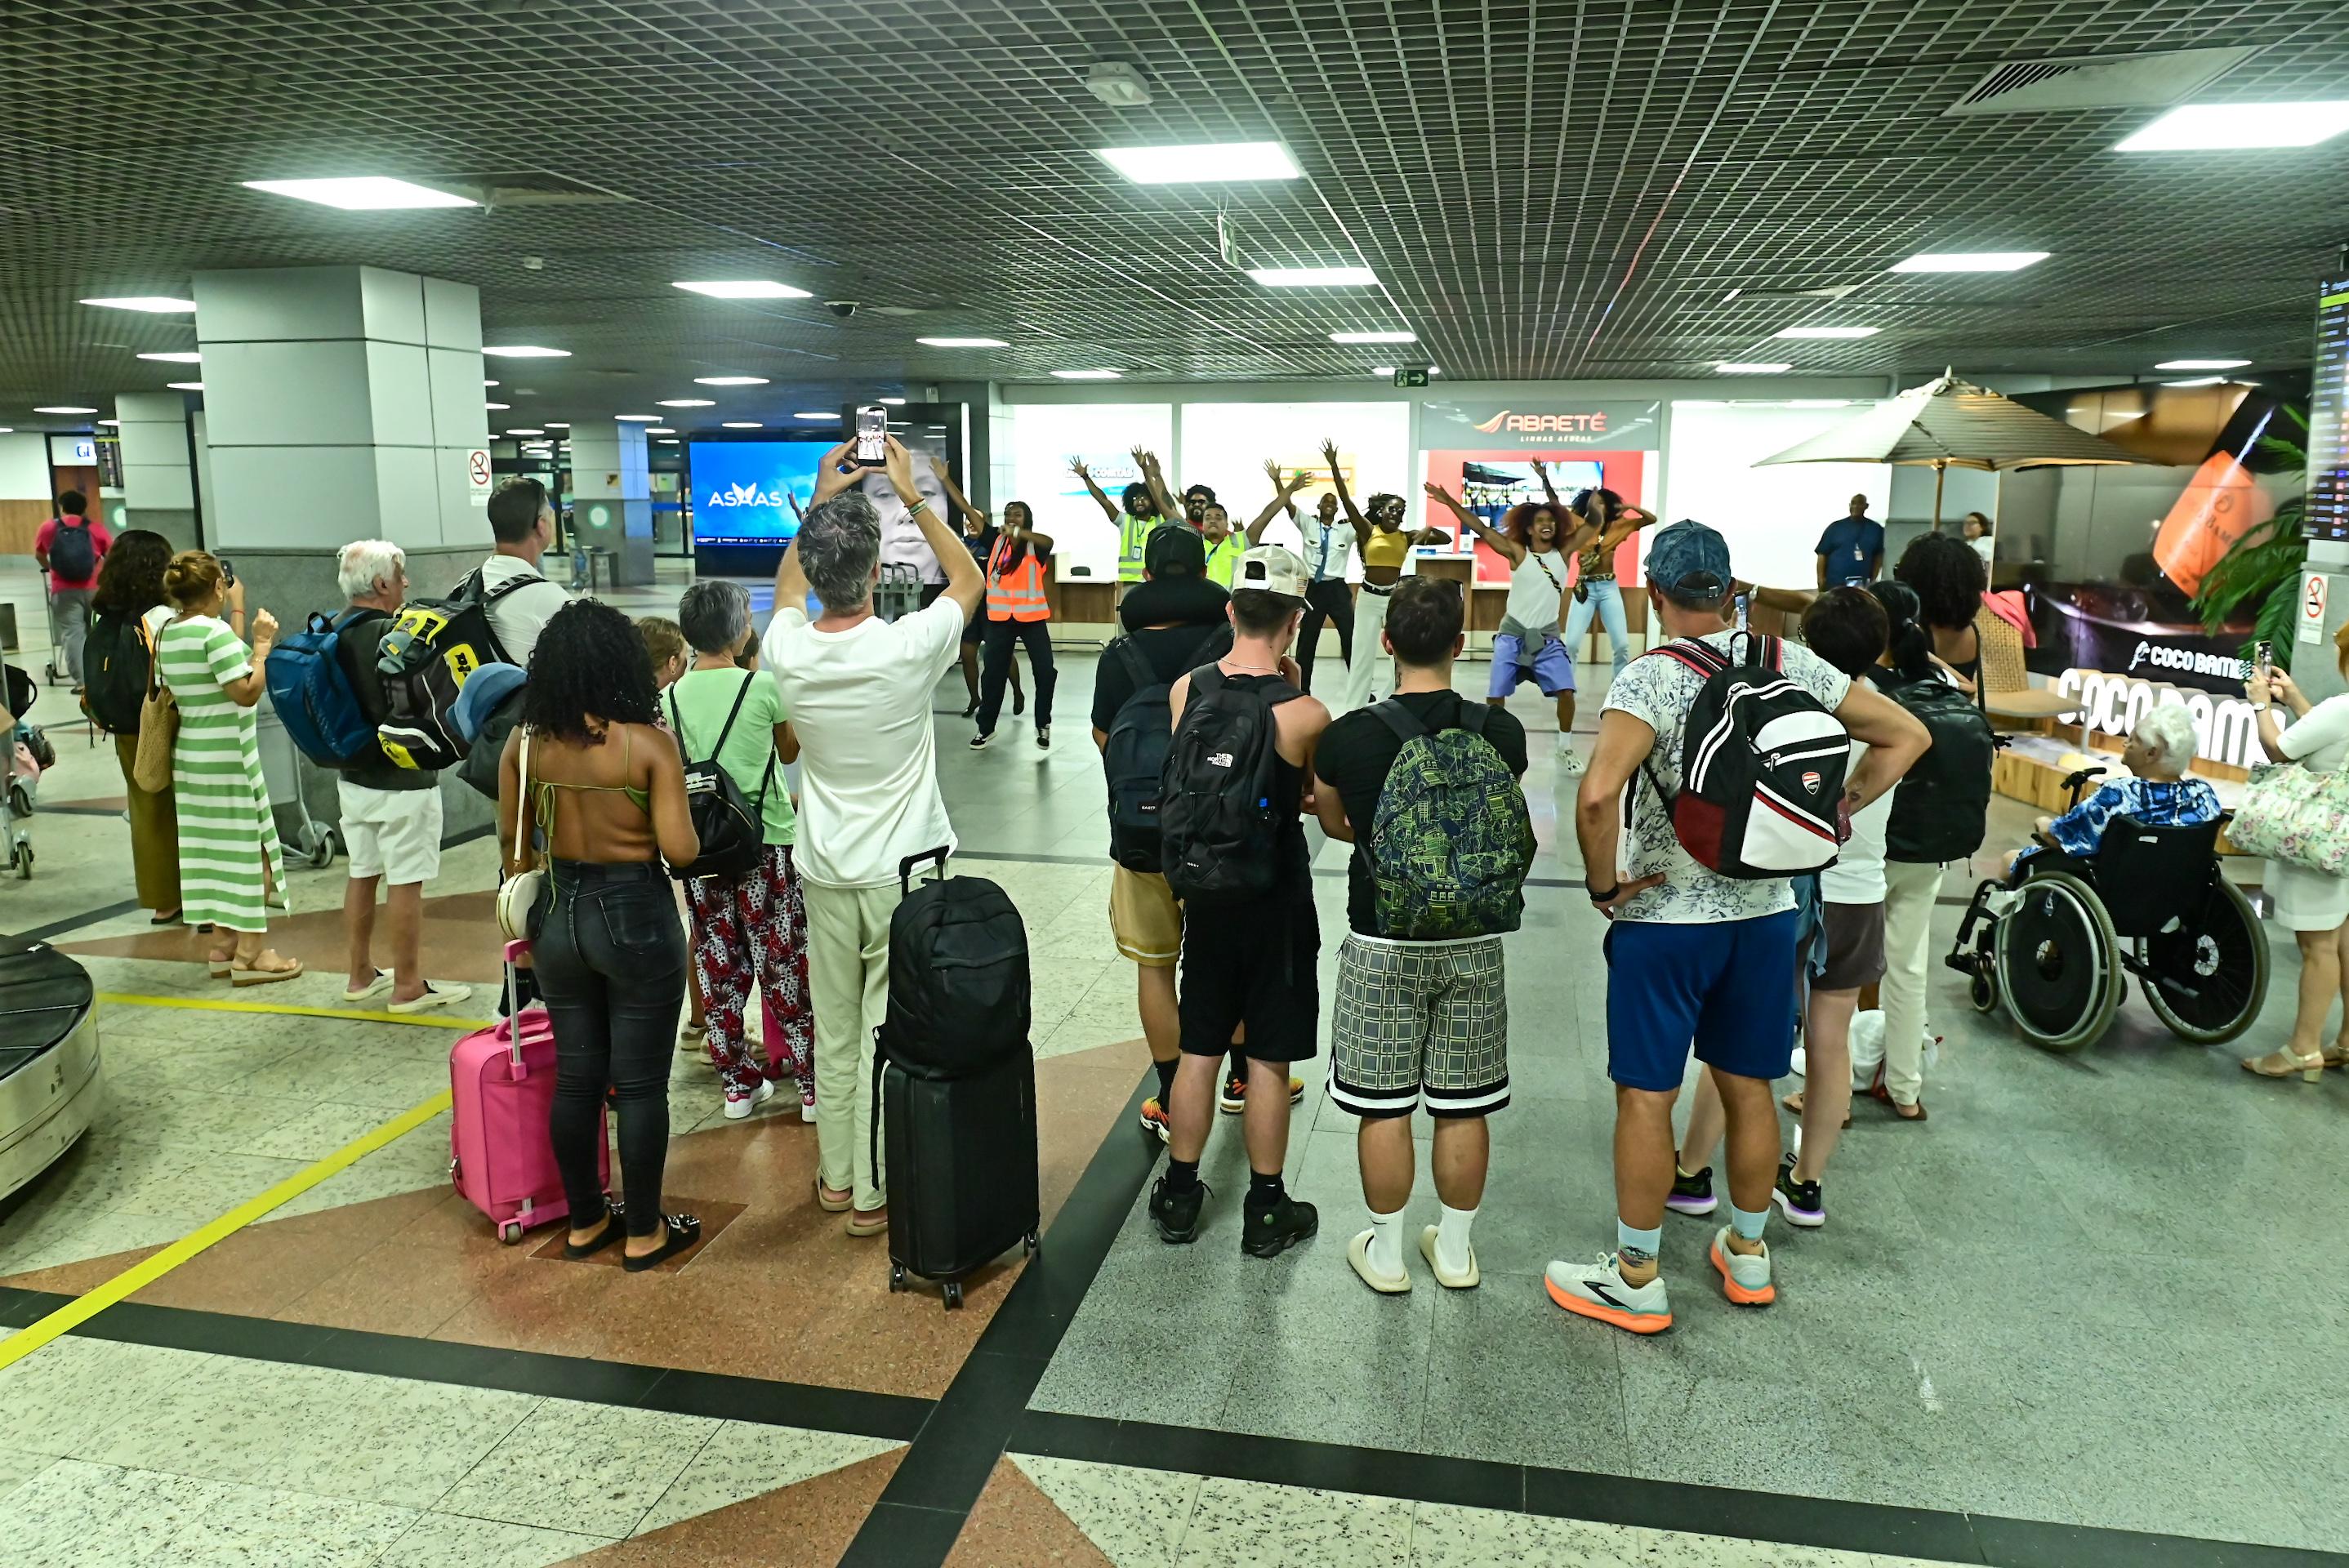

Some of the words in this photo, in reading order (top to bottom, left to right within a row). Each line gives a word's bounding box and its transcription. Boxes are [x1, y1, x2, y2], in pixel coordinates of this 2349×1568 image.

[1507, 412, 1607, 432] ABAETÉ
[2151, 645, 2195, 671] COCO
[2057, 667, 2154, 737] COCO
